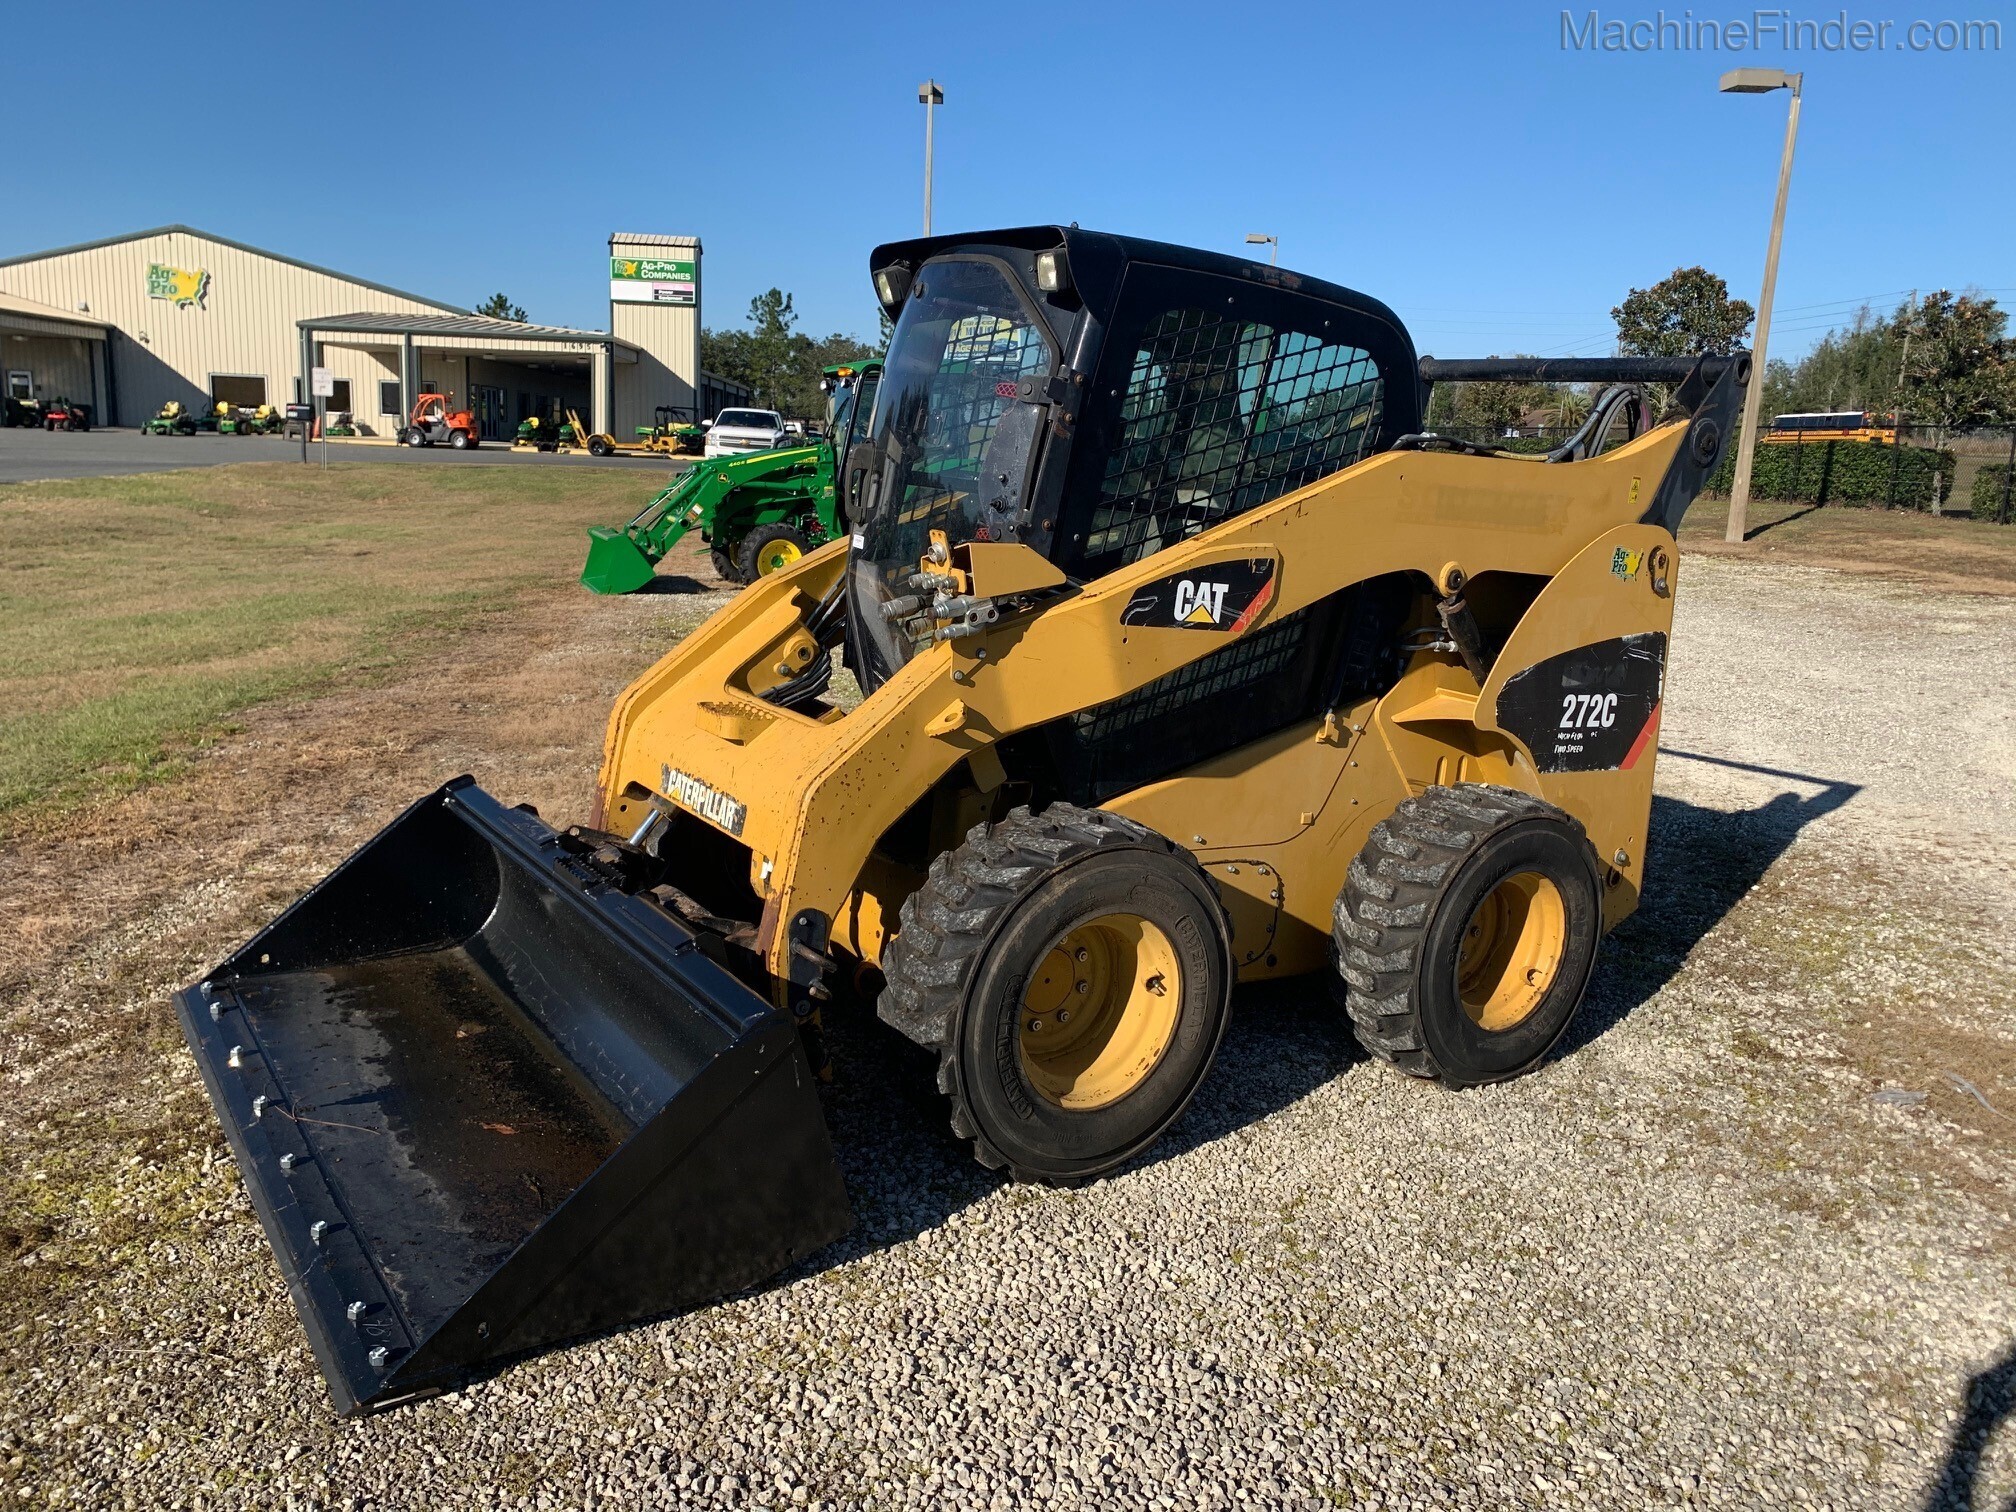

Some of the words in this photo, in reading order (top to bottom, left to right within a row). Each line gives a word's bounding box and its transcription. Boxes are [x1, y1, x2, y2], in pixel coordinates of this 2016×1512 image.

[149, 265, 176, 283] Ag-
[149, 280, 178, 294] Pro
[1613, 547, 1629, 562] Ag-
[1611, 560, 1628, 573] Pro
[1173, 579, 1230, 624] CAT
[1559, 692, 1618, 729] 272C
[1553, 744, 1567, 754] TWO
[1566, 744, 1584, 753] SPEED
[667, 768, 742, 831] CATERPILLAR
